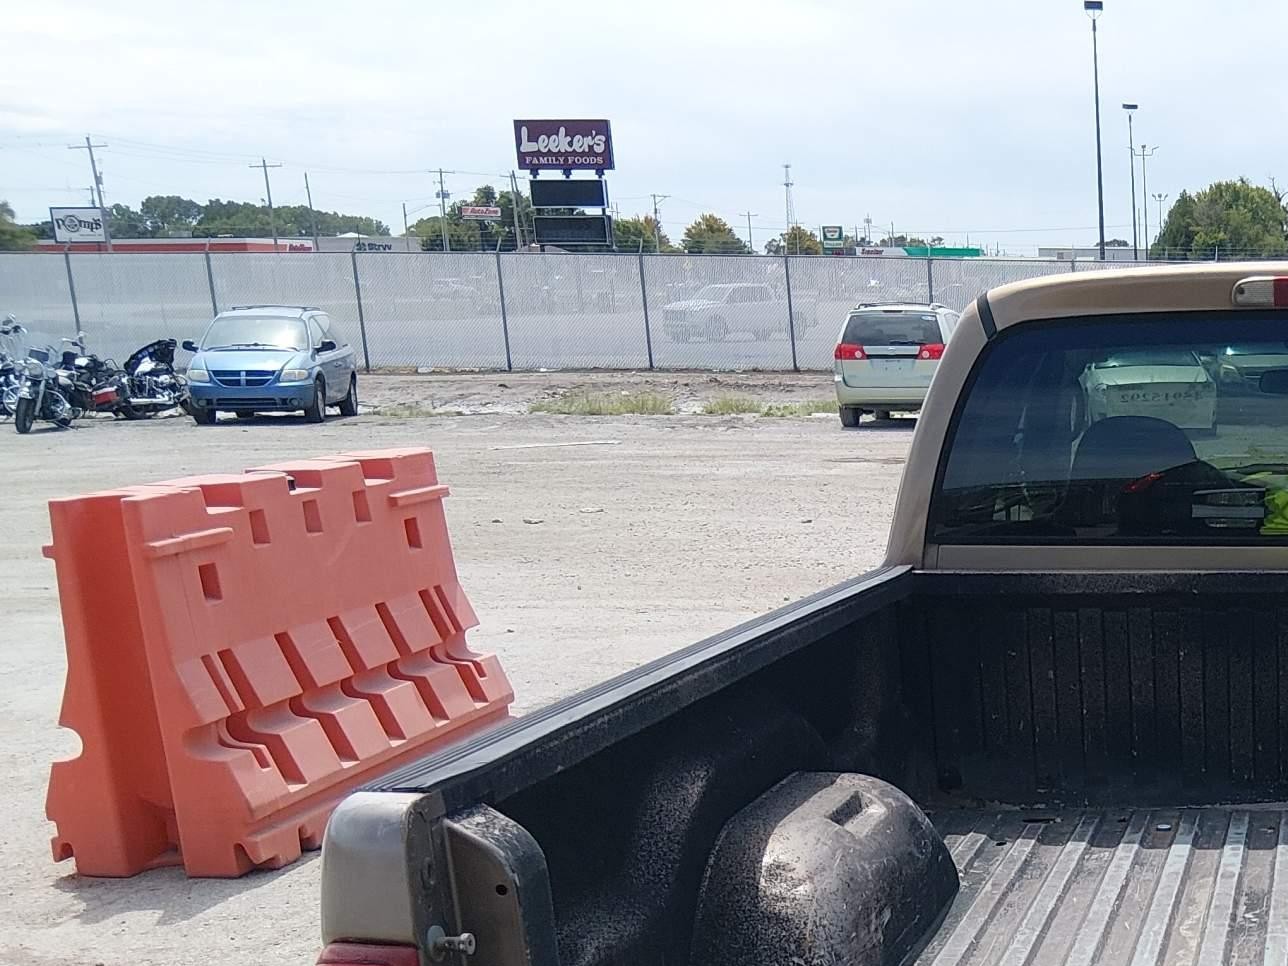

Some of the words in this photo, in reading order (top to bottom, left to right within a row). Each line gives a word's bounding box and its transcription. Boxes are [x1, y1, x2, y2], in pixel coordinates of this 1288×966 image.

[520, 126, 606, 153] Leeker's
[526, 156, 565, 164] FAMILY
[567, 156, 604, 164] FOODS
